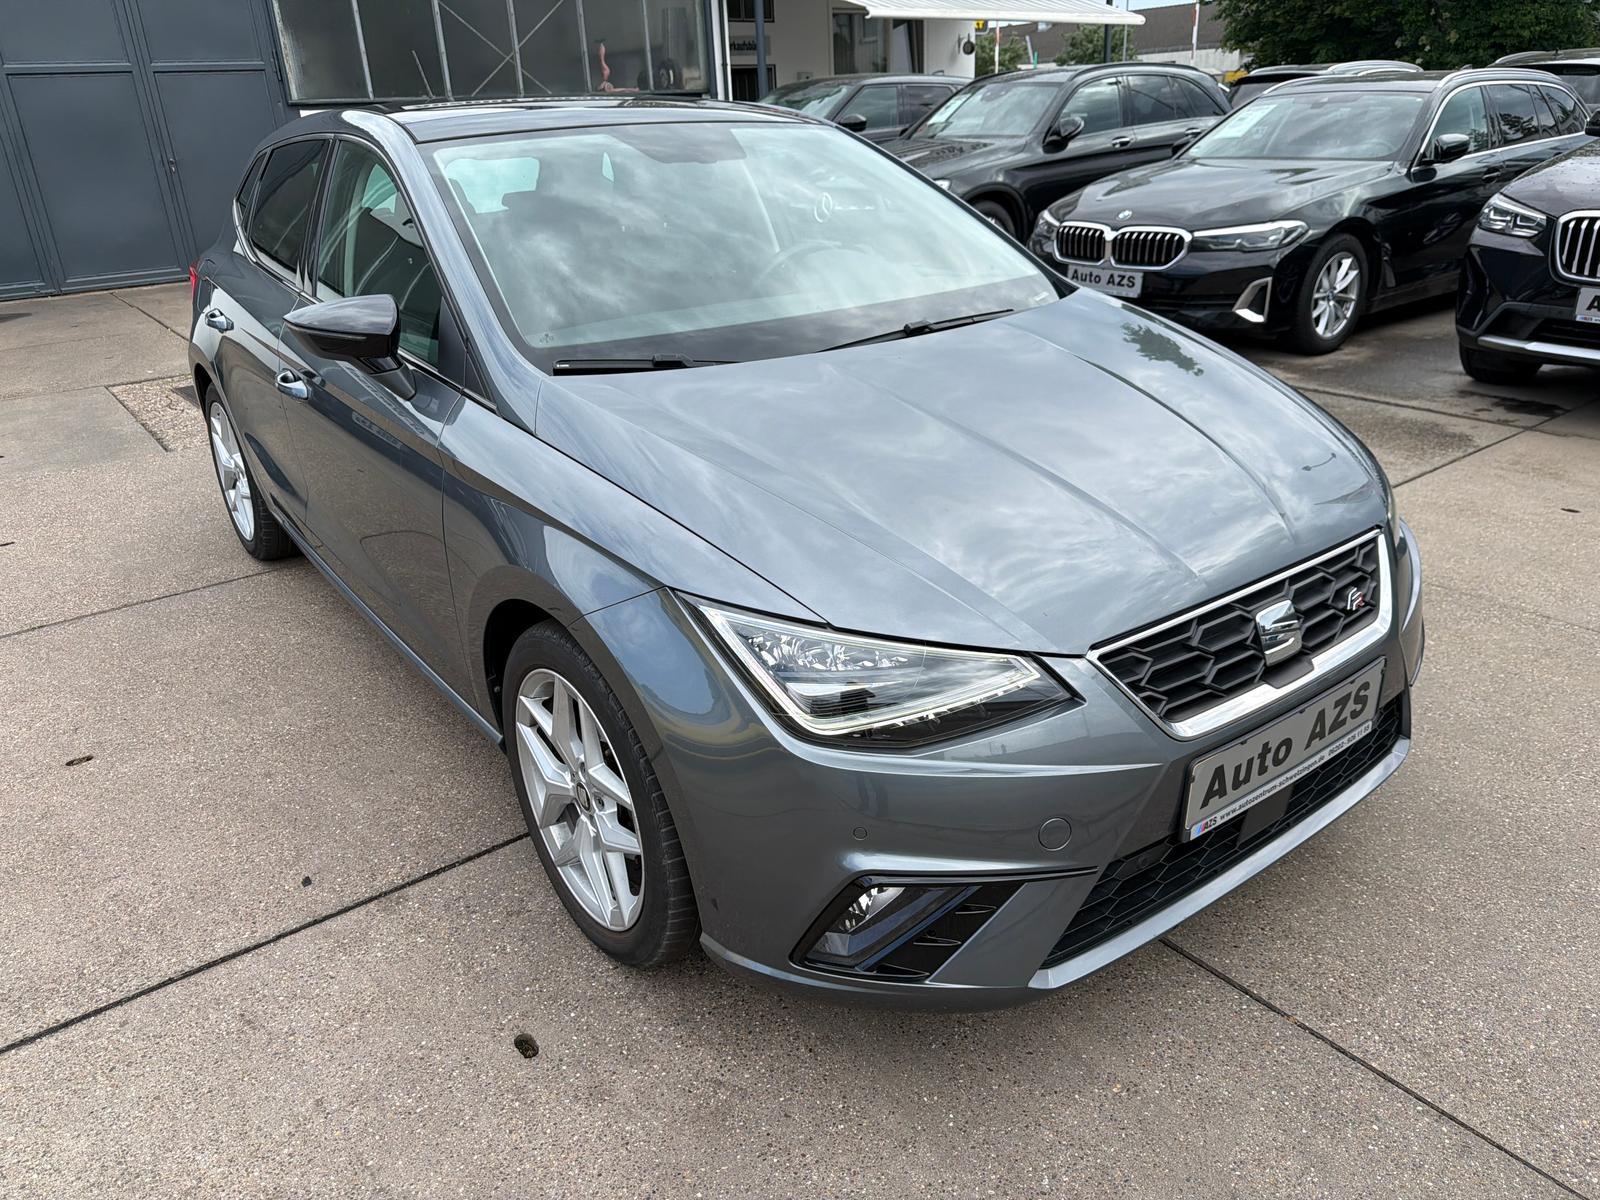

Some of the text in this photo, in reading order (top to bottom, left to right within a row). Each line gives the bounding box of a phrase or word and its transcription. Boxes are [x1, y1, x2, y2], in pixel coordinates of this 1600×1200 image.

[1071, 269, 1136, 288] Auto AZS
[1200, 681, 1370, 810] Auto AZS
